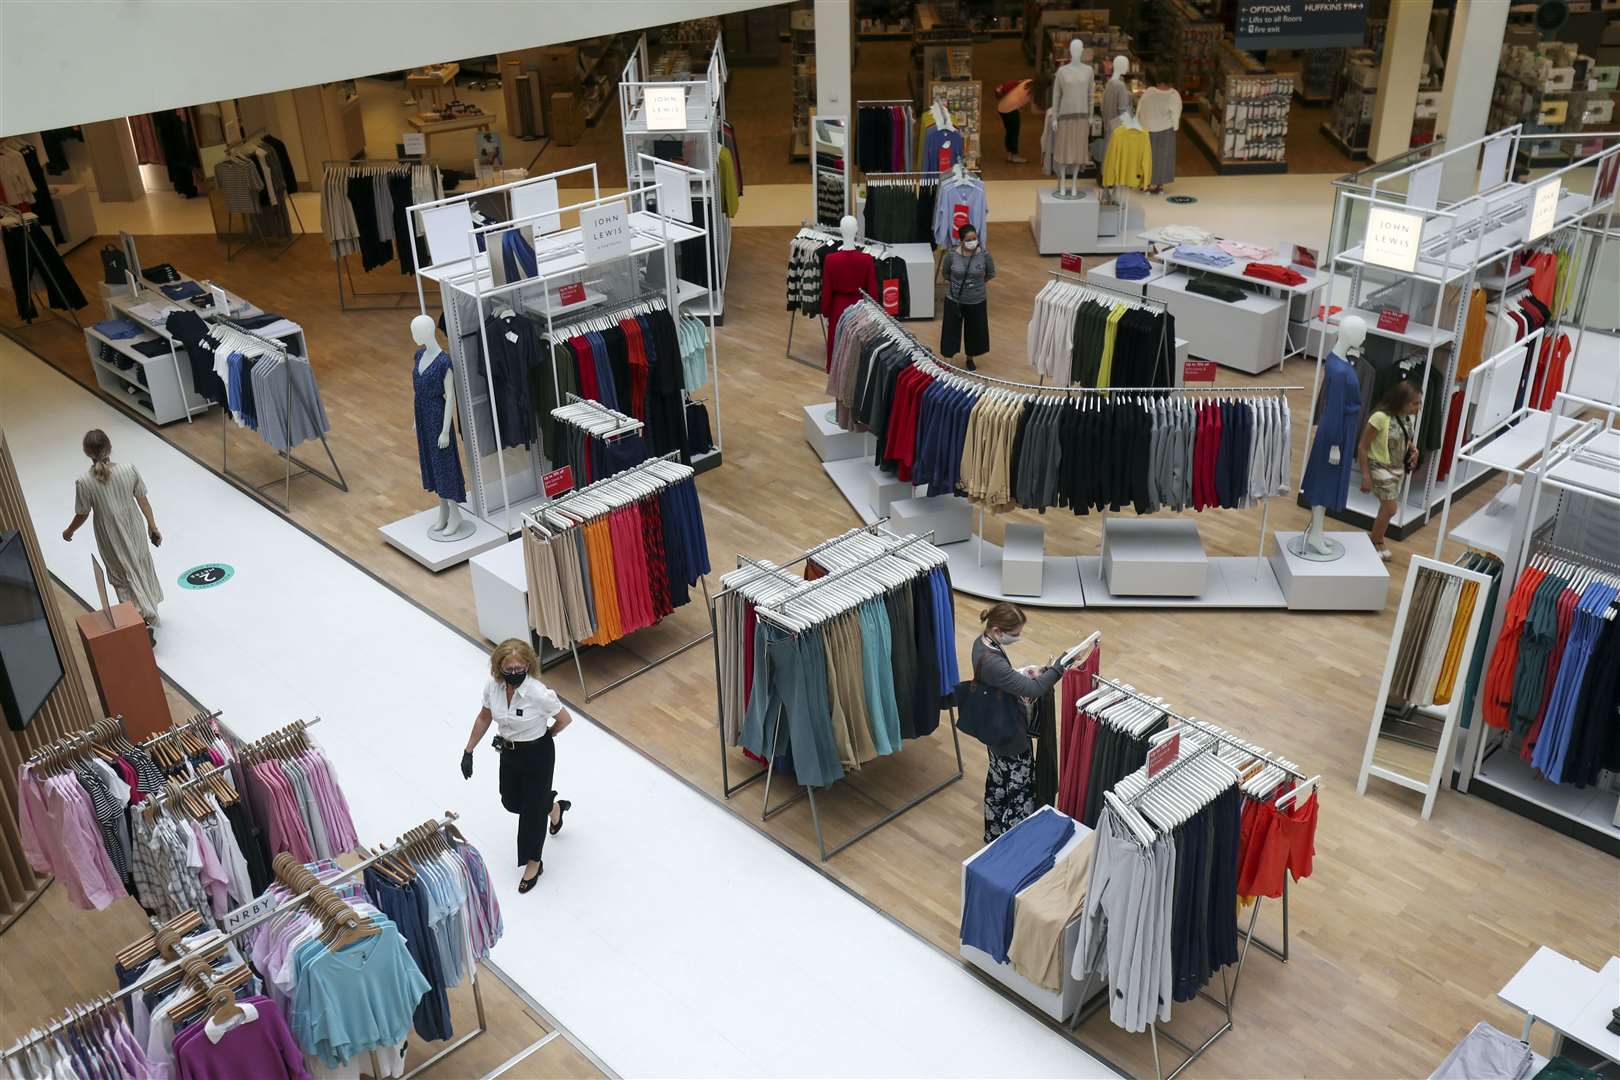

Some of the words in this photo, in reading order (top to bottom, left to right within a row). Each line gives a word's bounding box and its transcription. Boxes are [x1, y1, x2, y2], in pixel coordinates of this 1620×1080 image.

[1250, 5, 1291, 14] OPTICIANS
[1305, 3, 1342, 12] HUFFKINS
[1283, 15, 1303, 23] floors
[594, 215, 619, 227] JOHN
[1380, 220, 1410, 233] JOHN
[593, 227, 623, 241] LEWIS
[1375, 234, 1409, 248] LEWIS
[199, 572, 217, 582] 2
[229, 899, 269, 927] NRBY
